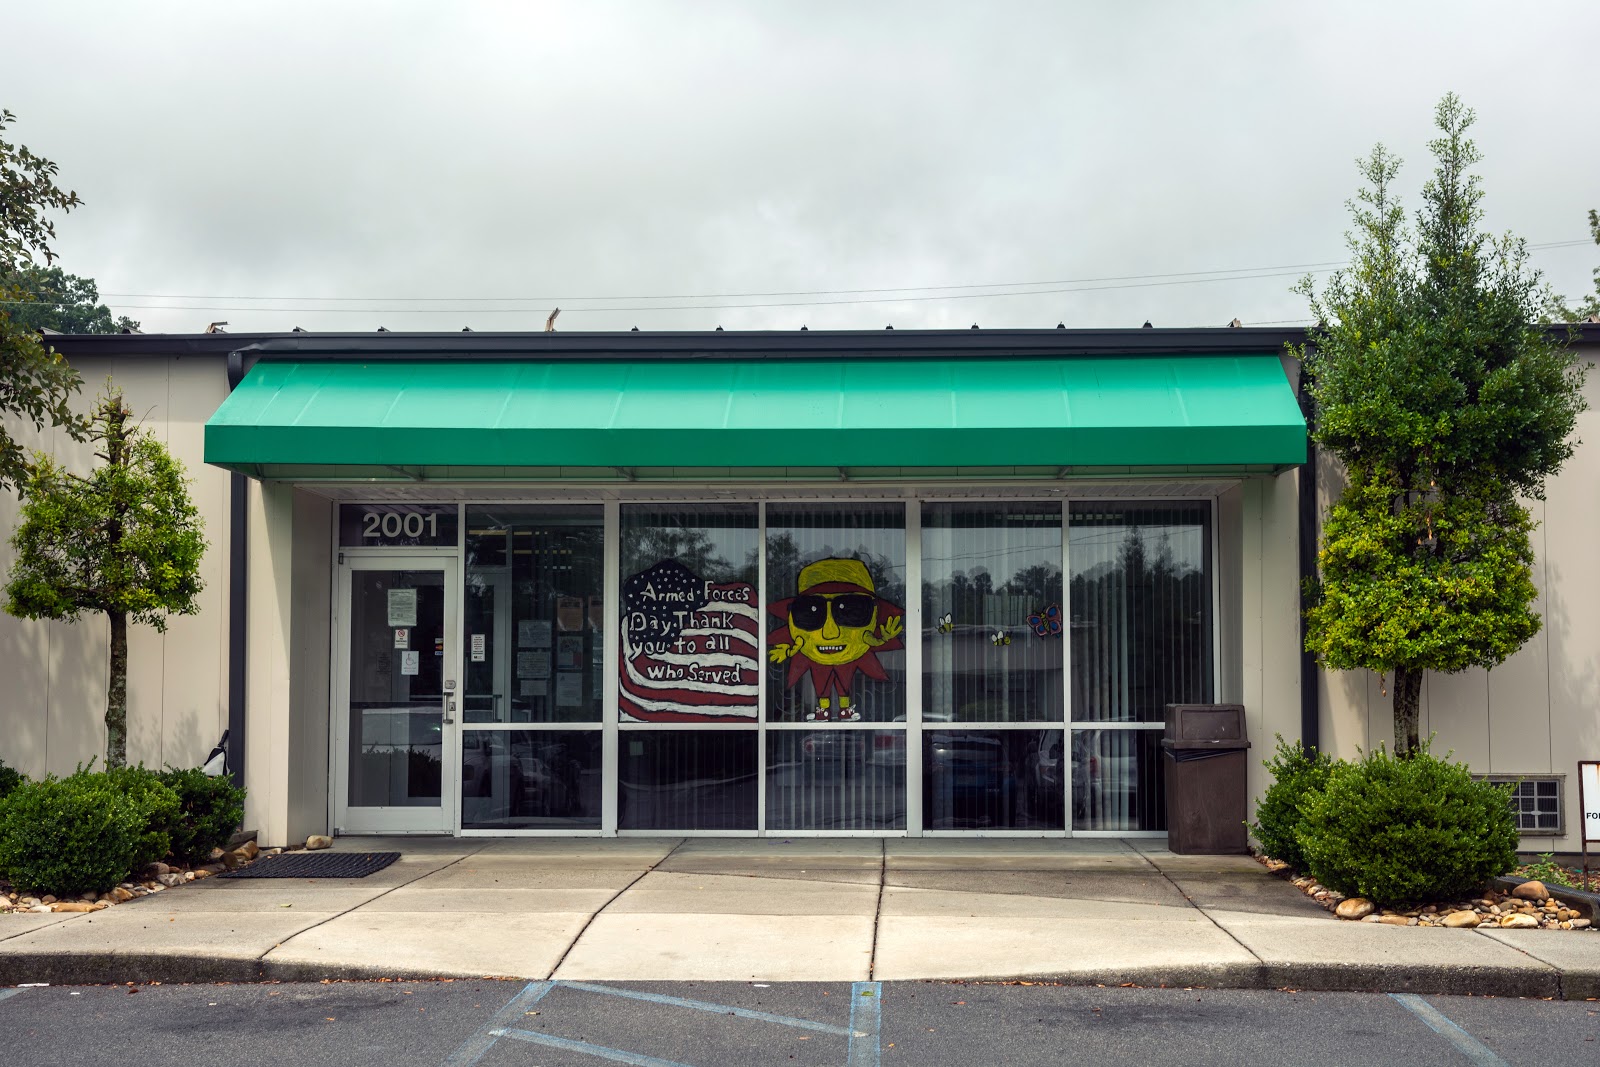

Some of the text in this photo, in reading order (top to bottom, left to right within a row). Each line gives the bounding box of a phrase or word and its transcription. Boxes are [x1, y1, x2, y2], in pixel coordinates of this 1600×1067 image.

[363, 512, 436, 537] 2001
[640, 580, 750, 601] Armed Forces
[674, 637, 696, 653] to
[706, 636, 730, 650] all
[688, 663, 741, 683] Served
[1586, 812, 1600, 820] FO
